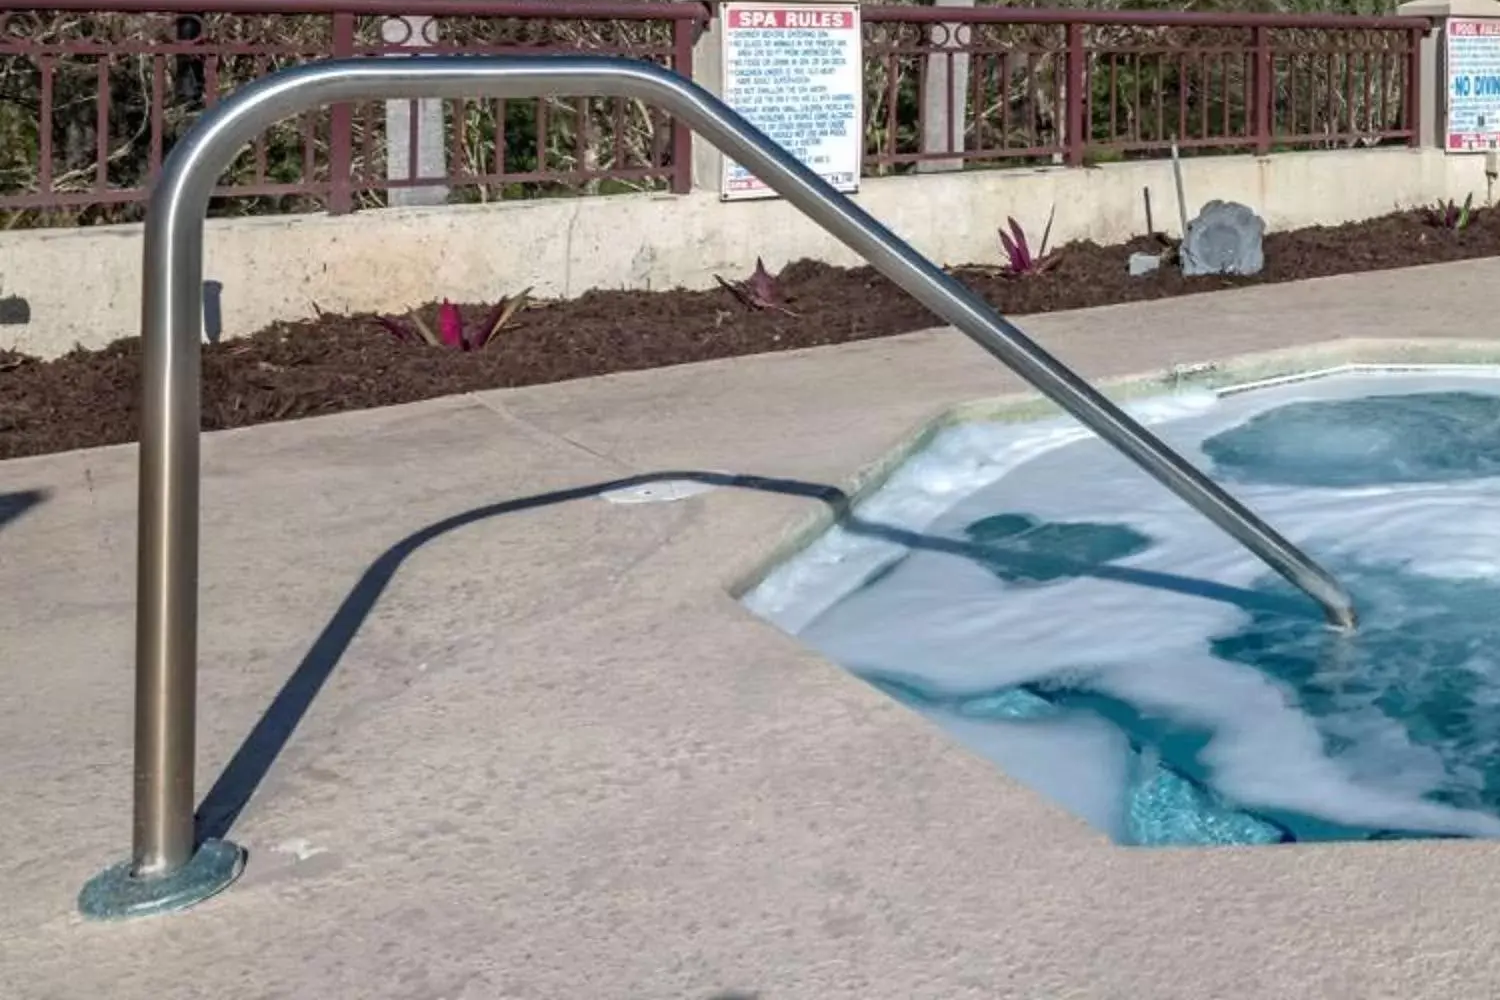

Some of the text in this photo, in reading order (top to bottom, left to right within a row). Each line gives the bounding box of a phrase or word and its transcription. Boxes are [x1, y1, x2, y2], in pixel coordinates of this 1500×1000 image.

[739, 11, 844, 27] SPA RULES
[1455, 75, 1470, 96] NO
